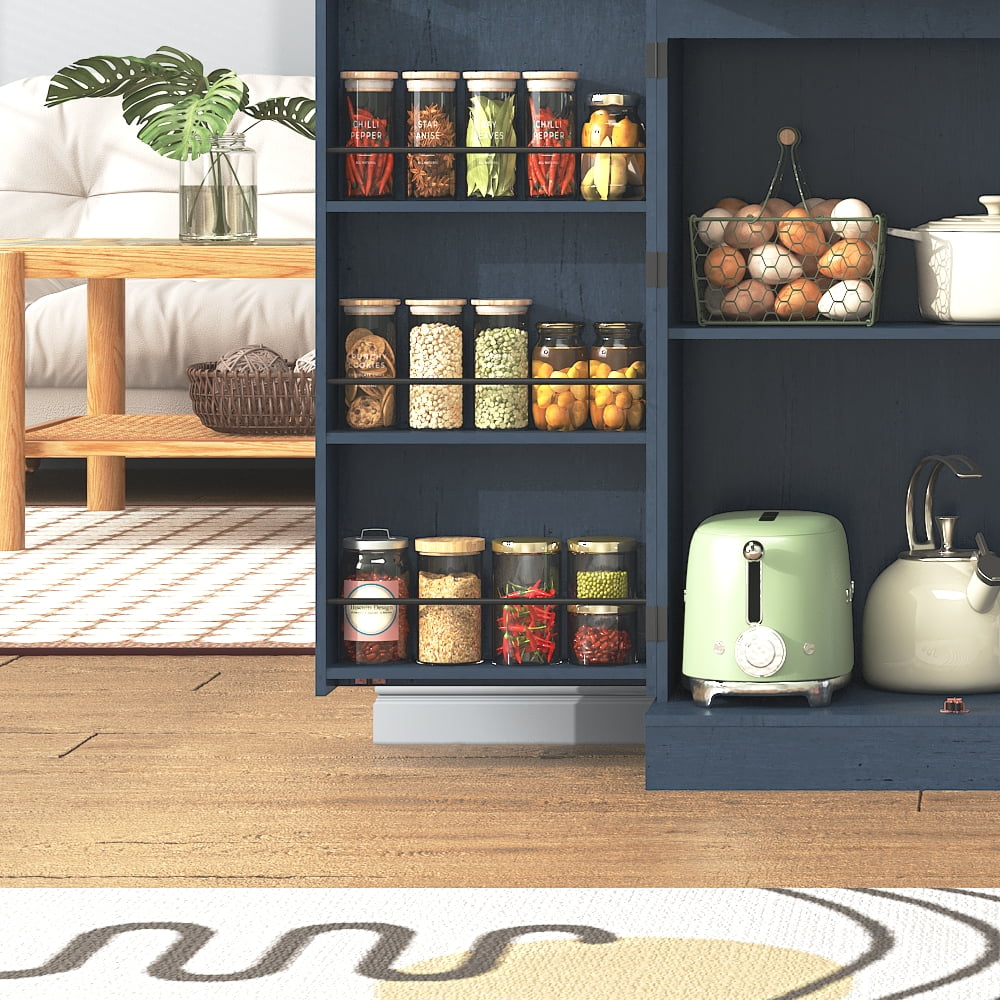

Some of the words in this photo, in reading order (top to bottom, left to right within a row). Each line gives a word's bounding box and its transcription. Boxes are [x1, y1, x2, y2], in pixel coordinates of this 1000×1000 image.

[352, 120, 379, 129] CHILLI
[417, 120, 438, 129] STAR
[535, 120, 562, 129] CHILLI
[350, 131, 382, 140] PEPPER
[415, 131, 440, 140] ANISE
[533, 131, 565, 140] PEPPER
[348, 361, 386, 369] COOKIES
